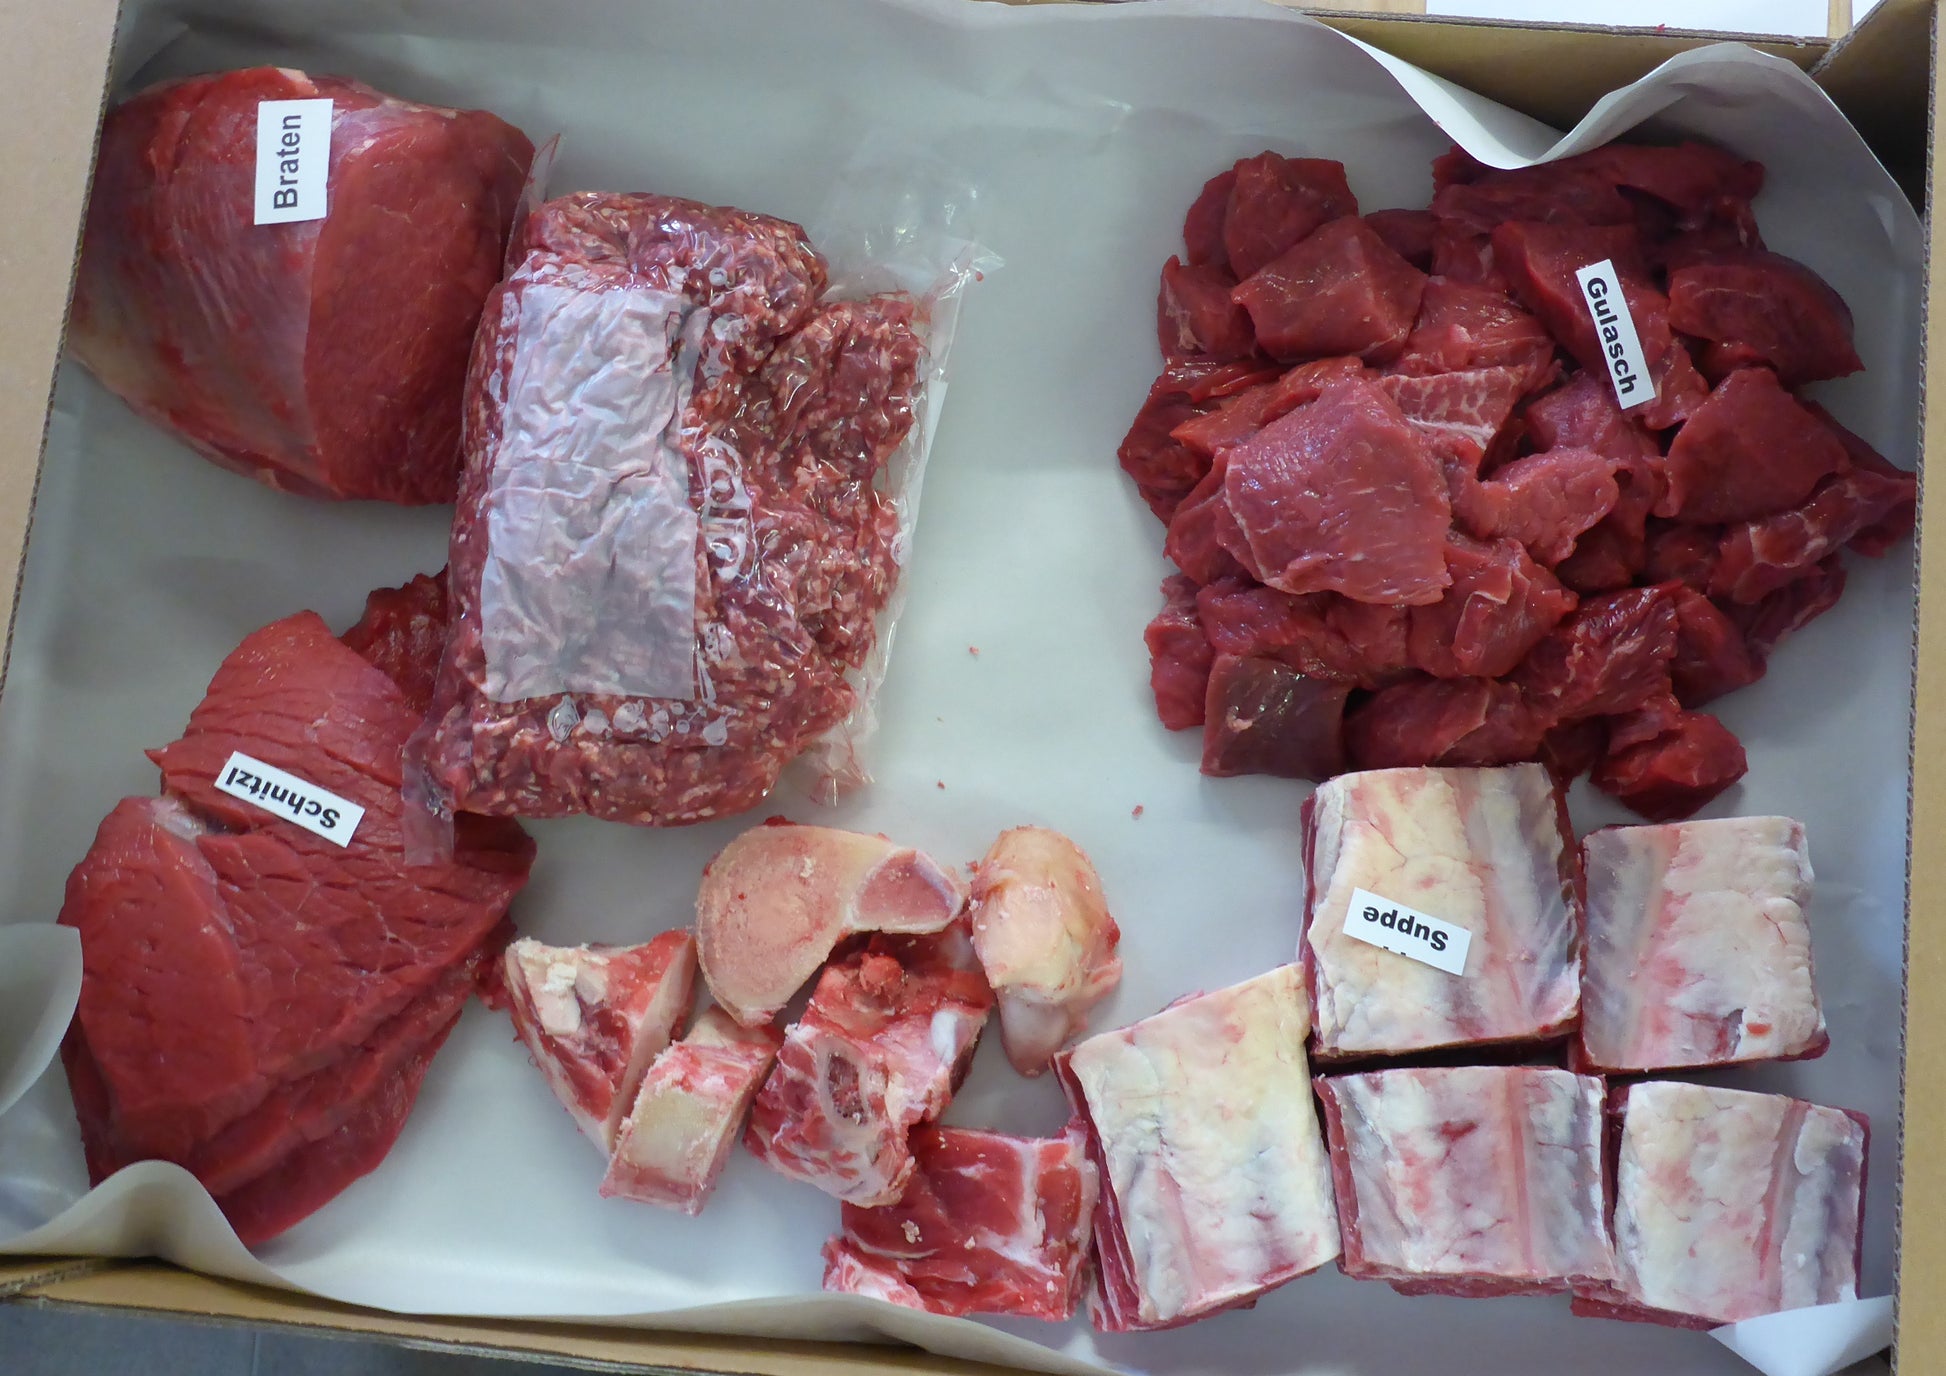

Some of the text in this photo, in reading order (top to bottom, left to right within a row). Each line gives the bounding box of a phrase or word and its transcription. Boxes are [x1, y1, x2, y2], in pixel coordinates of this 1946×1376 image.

[274, 115, 301, 209] Braten
[1587, 277, 1638, 395] Gulasch
[225, 767, 341, 829] Schnitzl
[1362, 906, 1449, 952] Suppe
